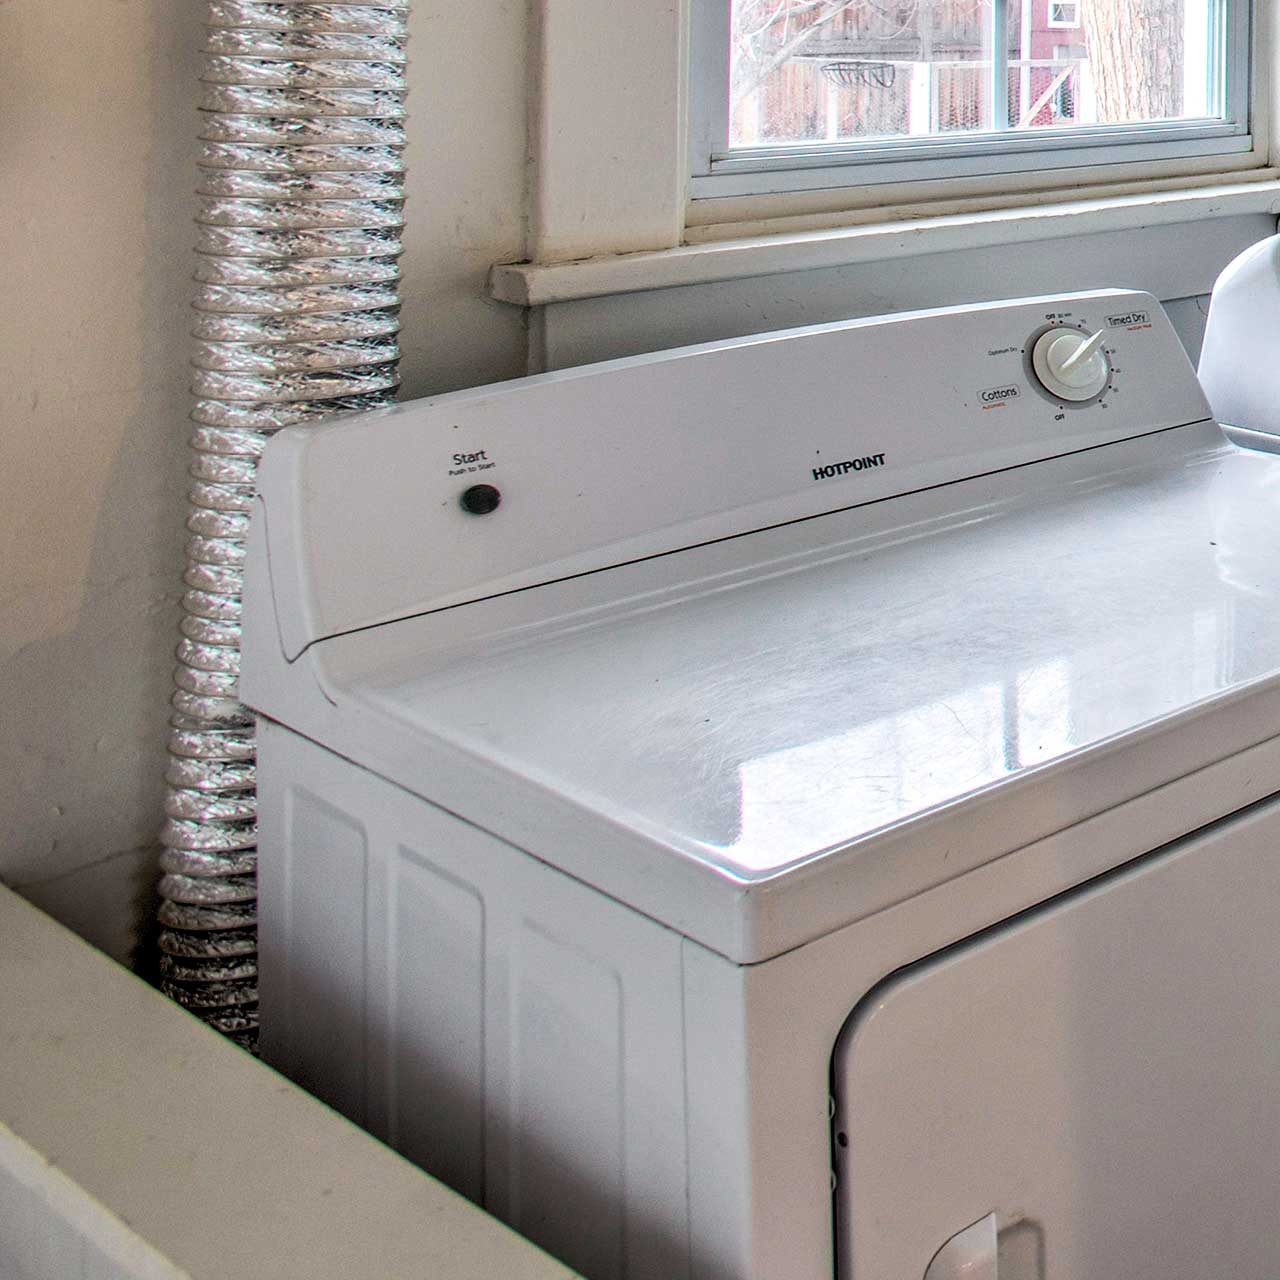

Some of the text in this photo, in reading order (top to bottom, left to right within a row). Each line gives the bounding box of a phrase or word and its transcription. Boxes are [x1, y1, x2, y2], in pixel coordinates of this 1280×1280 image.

[1108, 314, 1146, 326] Timed Dry
[981, 388, 1017, 402] Cottons
[453, 450, 488, 466] Start
[448, 468, 466, 476] Push
[478, 462, 496, 470] Start
[812, 453, 886, 480] HOTPOINT
